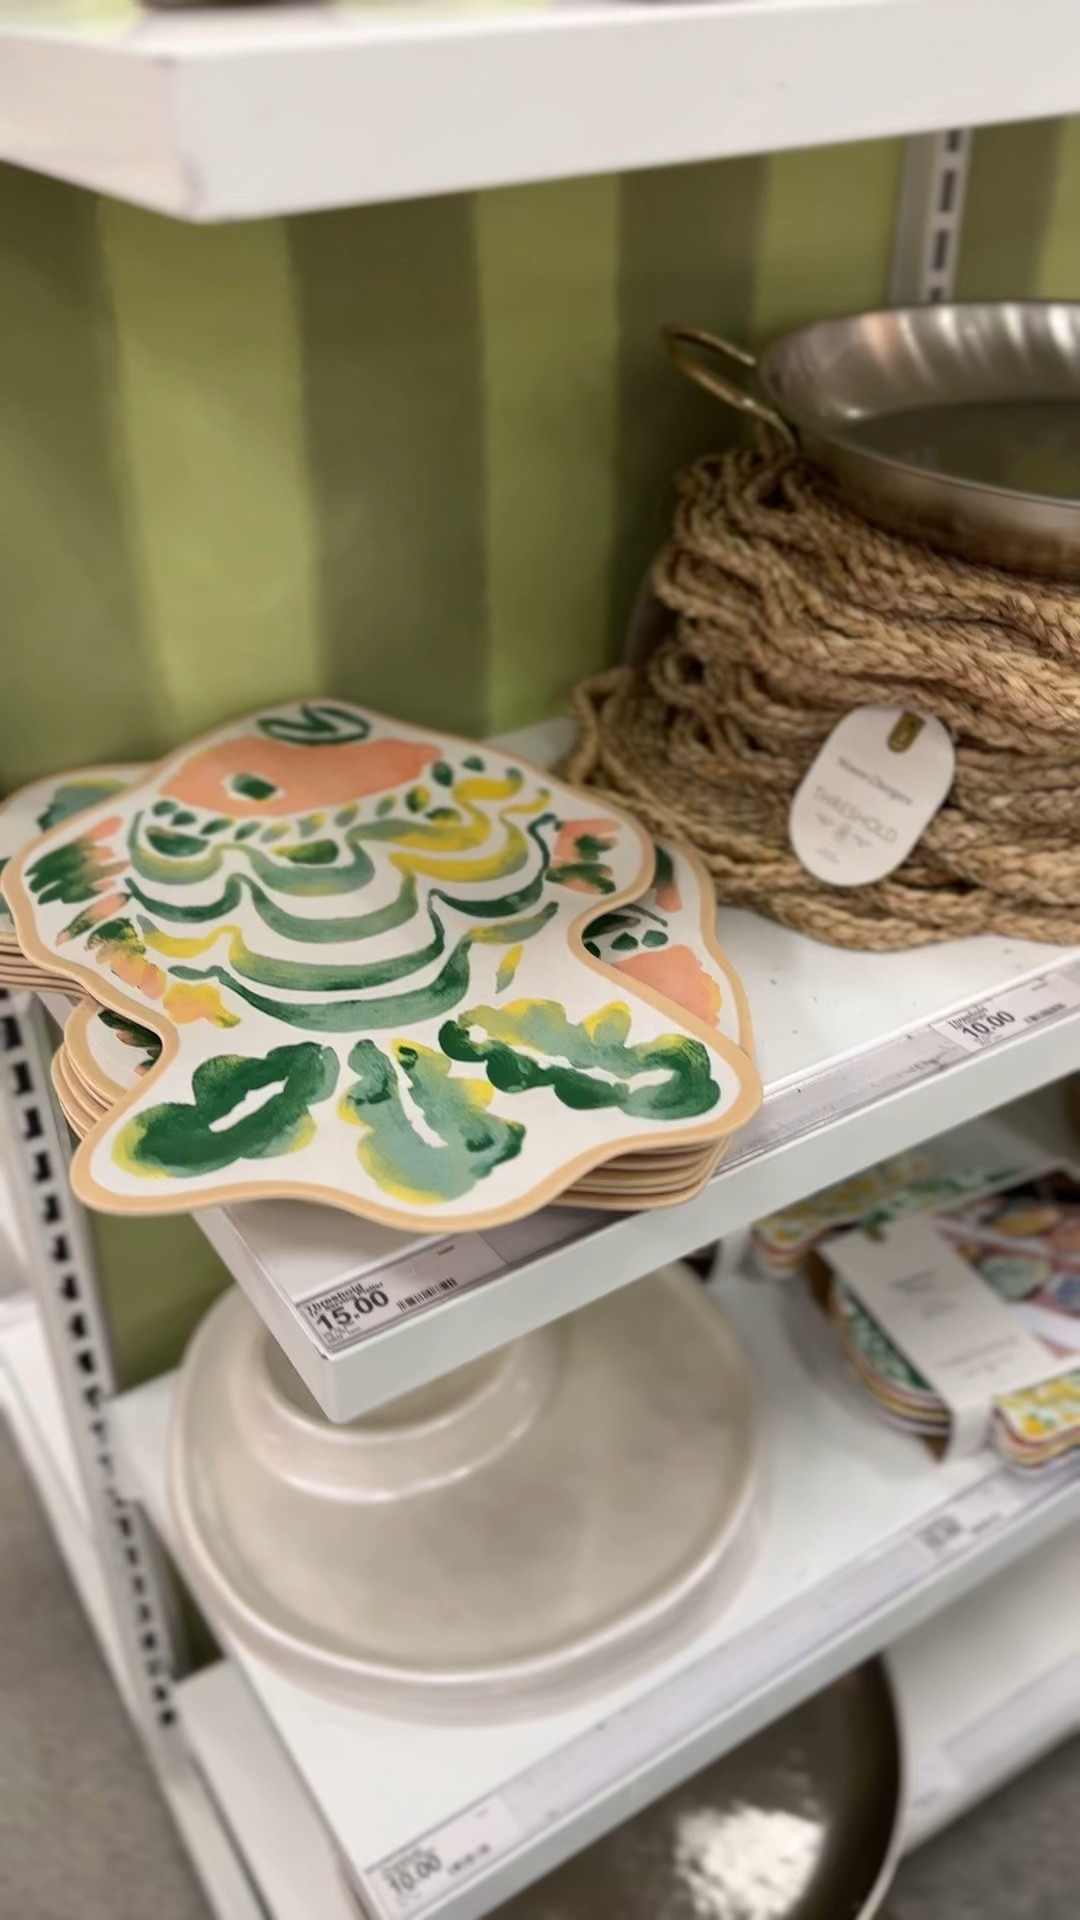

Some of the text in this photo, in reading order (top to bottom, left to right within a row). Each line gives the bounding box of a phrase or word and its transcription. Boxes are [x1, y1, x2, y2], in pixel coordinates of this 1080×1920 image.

[962, 1010, 1016, 1039] 10.00
[305, 1282, 366, 1314] Threshold
[316, 1289, 390, 1331] 15.00
[387, 1853, 443, 1896] 10.00
